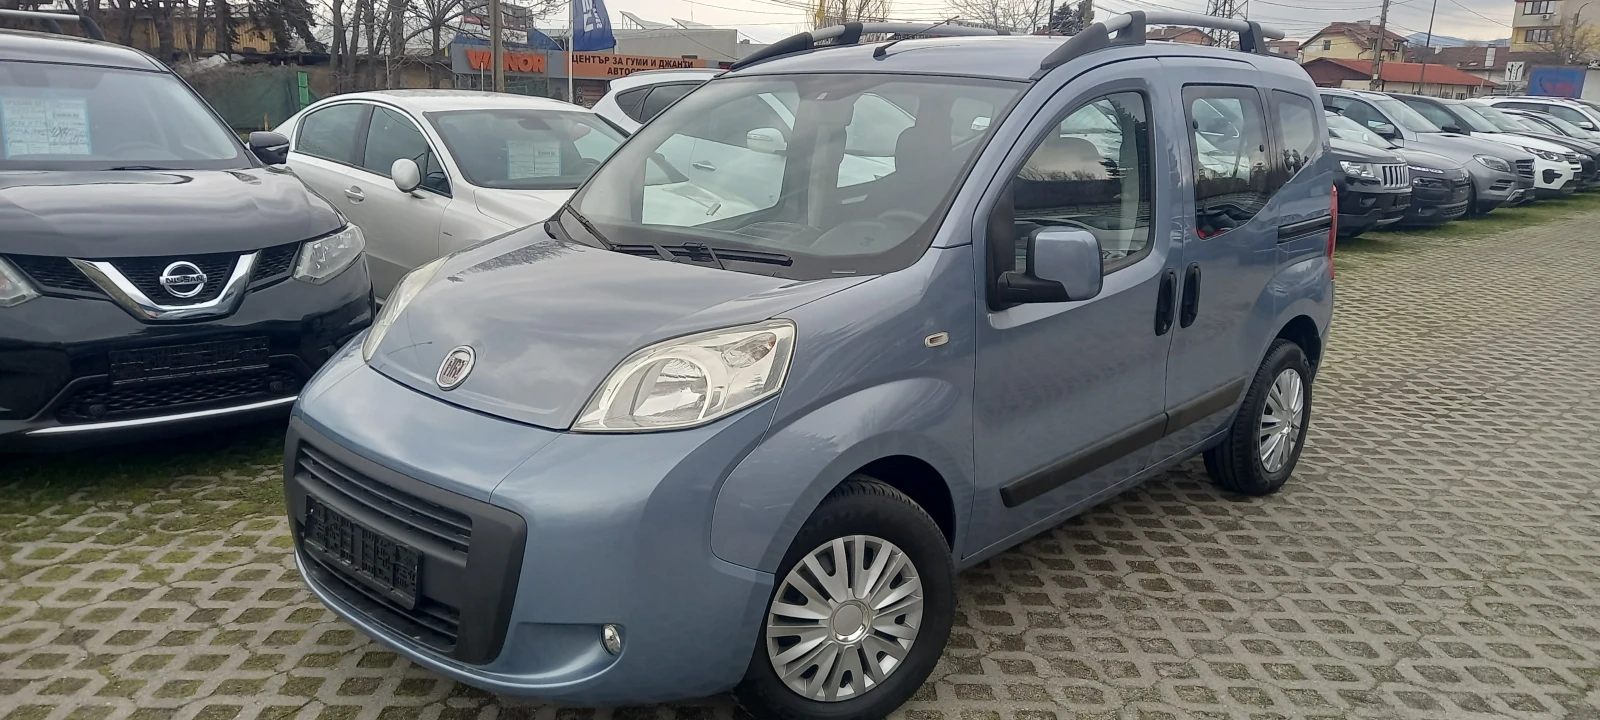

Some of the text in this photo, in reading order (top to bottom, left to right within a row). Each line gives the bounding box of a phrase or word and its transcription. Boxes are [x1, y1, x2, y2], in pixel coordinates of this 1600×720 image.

[466, 49, 545, 73] VINOR
[572, 54, 694, 69] ЦЕНТЪР ЗА ГУМИ И ДЖАНТИ
[165, 274, 205, 284] NISSAN
